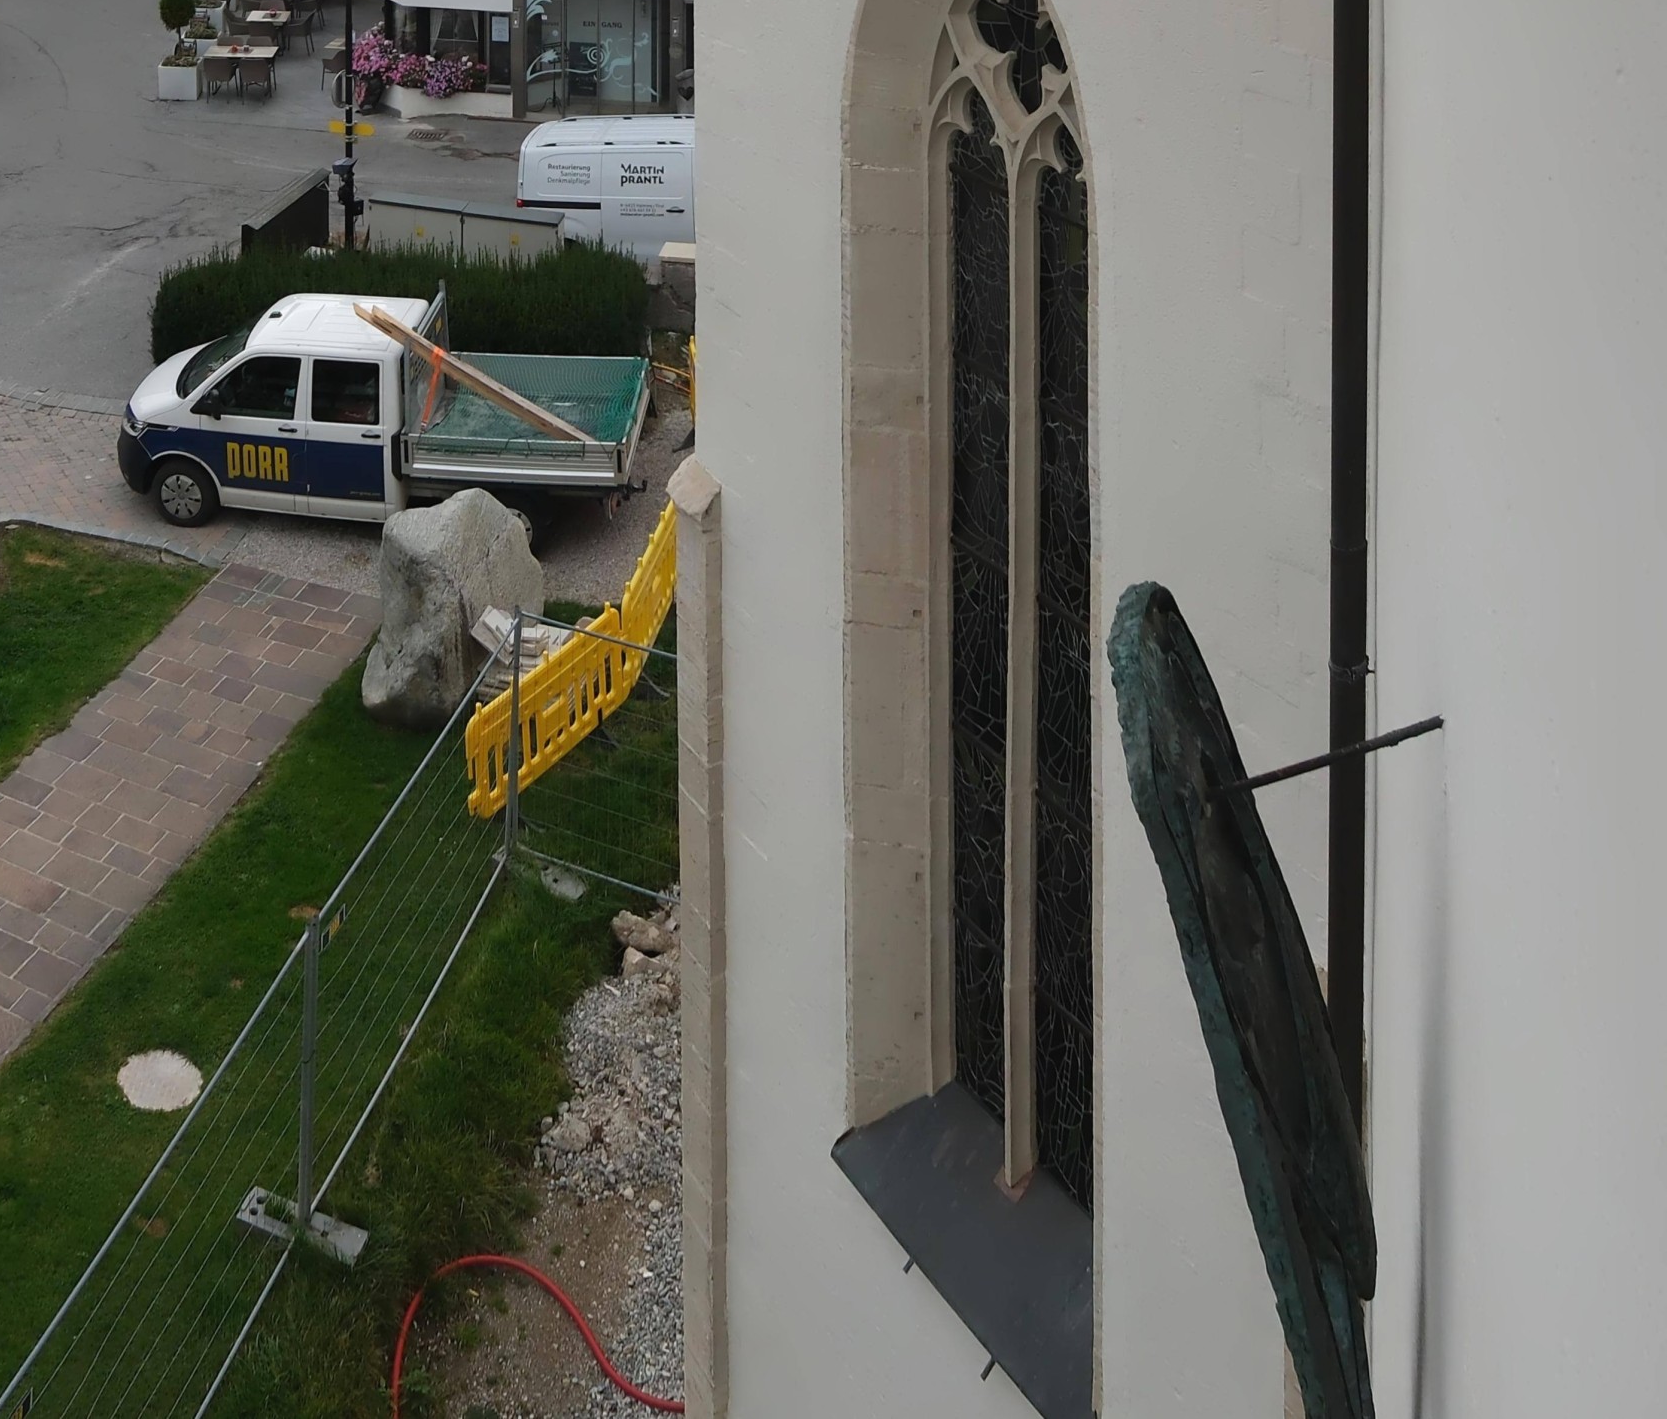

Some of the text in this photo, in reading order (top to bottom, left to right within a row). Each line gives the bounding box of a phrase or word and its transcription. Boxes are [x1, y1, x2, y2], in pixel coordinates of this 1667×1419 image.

[582, 20, 623, 29] EIN GANG
[547, 163, 591, 172] Restaurierung
[620, 163, 665, 175] MARTIN
[560, 171, 591, 179] Sanierung
[547, 177, 591, 186] Denkmalpflege
[620, 175, 665, 187] PRANTL
[226, 441, 290, 482] PORR
